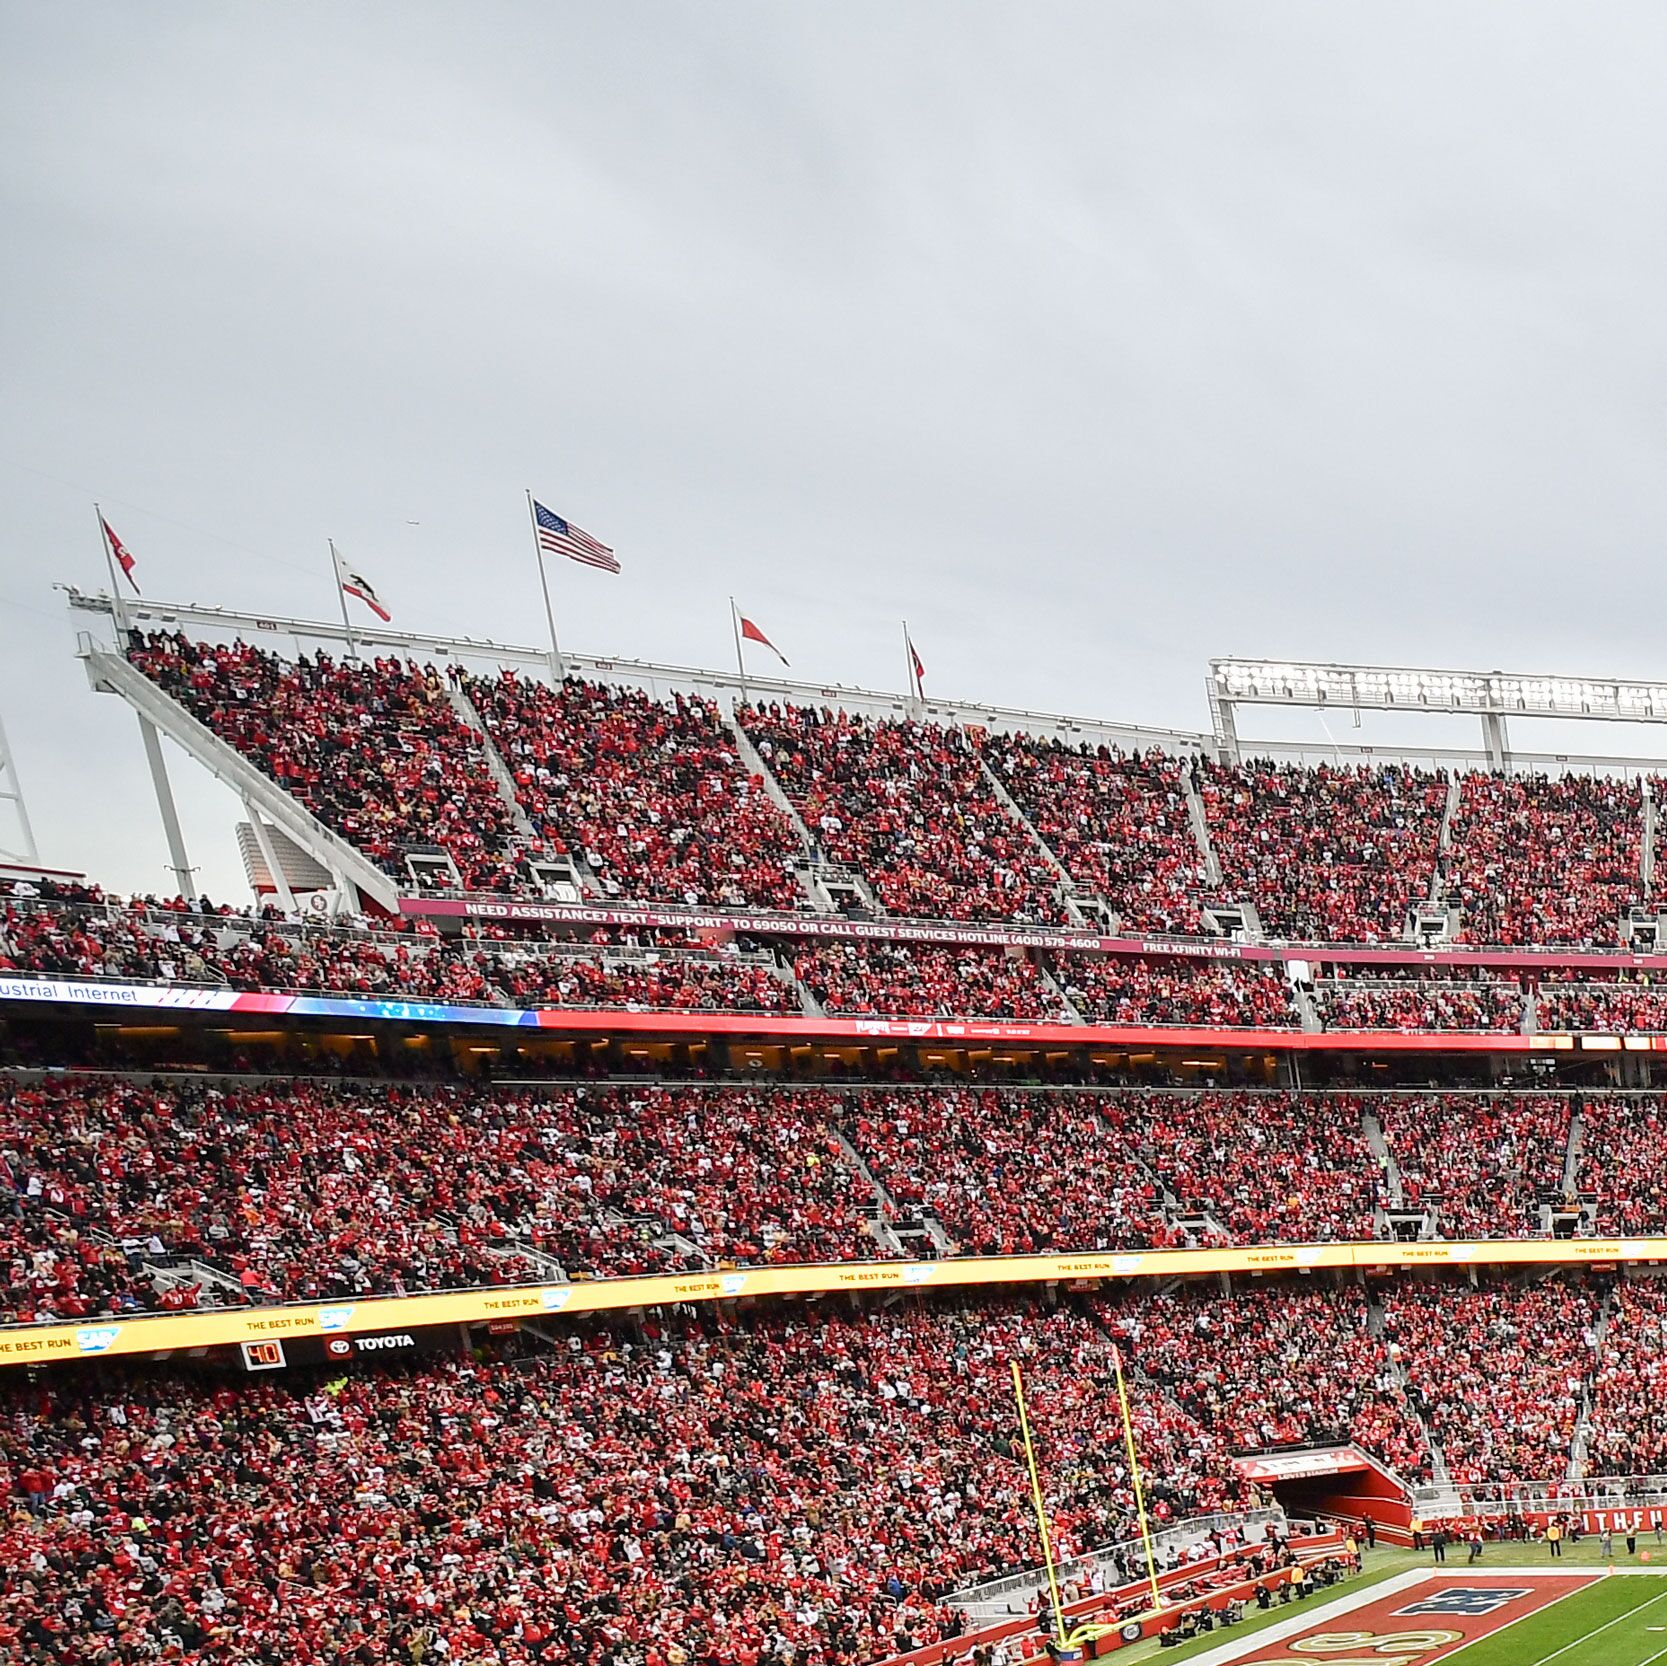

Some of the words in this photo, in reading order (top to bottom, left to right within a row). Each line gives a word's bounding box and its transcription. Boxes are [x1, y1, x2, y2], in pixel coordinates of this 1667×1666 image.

[466, 903, 507, 916] NEED
[511, 906, 608, 922] ASSISTANCE?
[611, 911, 648, 924] TEXT
[732, 918, 750, 929] TO
[752, 918, 797, 933] 69050
[800, 922, 817, 933] OR
[820, 924, 854, 936] CALL
[856, 925, 895, 939] GUEST
[898, 928, 956, 942] SERVICES
[959, 931, 1009, 945] HOTLINE
[1011, 933, 1043, 946] (408)
[1045, 934, 1100, 949] 579-4600
[1143, 942, 1170, 953] FREE
[1172, 944, 1213, 956] XFINITY
[1215, 946, 1241, 958] WI-FI
[68, 986, 138, 1003] Internet
[502, 1300, 520, 1309] BEST
[523, 1298, 538, 1307] RUN
[247, 1321, 266, 1330] THE
[269, 1320, 292, 1330] BEST
[295, 1317, 314, 1327] RUN
[16, 1341, 42, 1351] BEST
[47, 1339, 71, 1348] RUN
[355, 1335, 415, 1351] TOYOTA
[247, 1344, 278, 1365] 40
